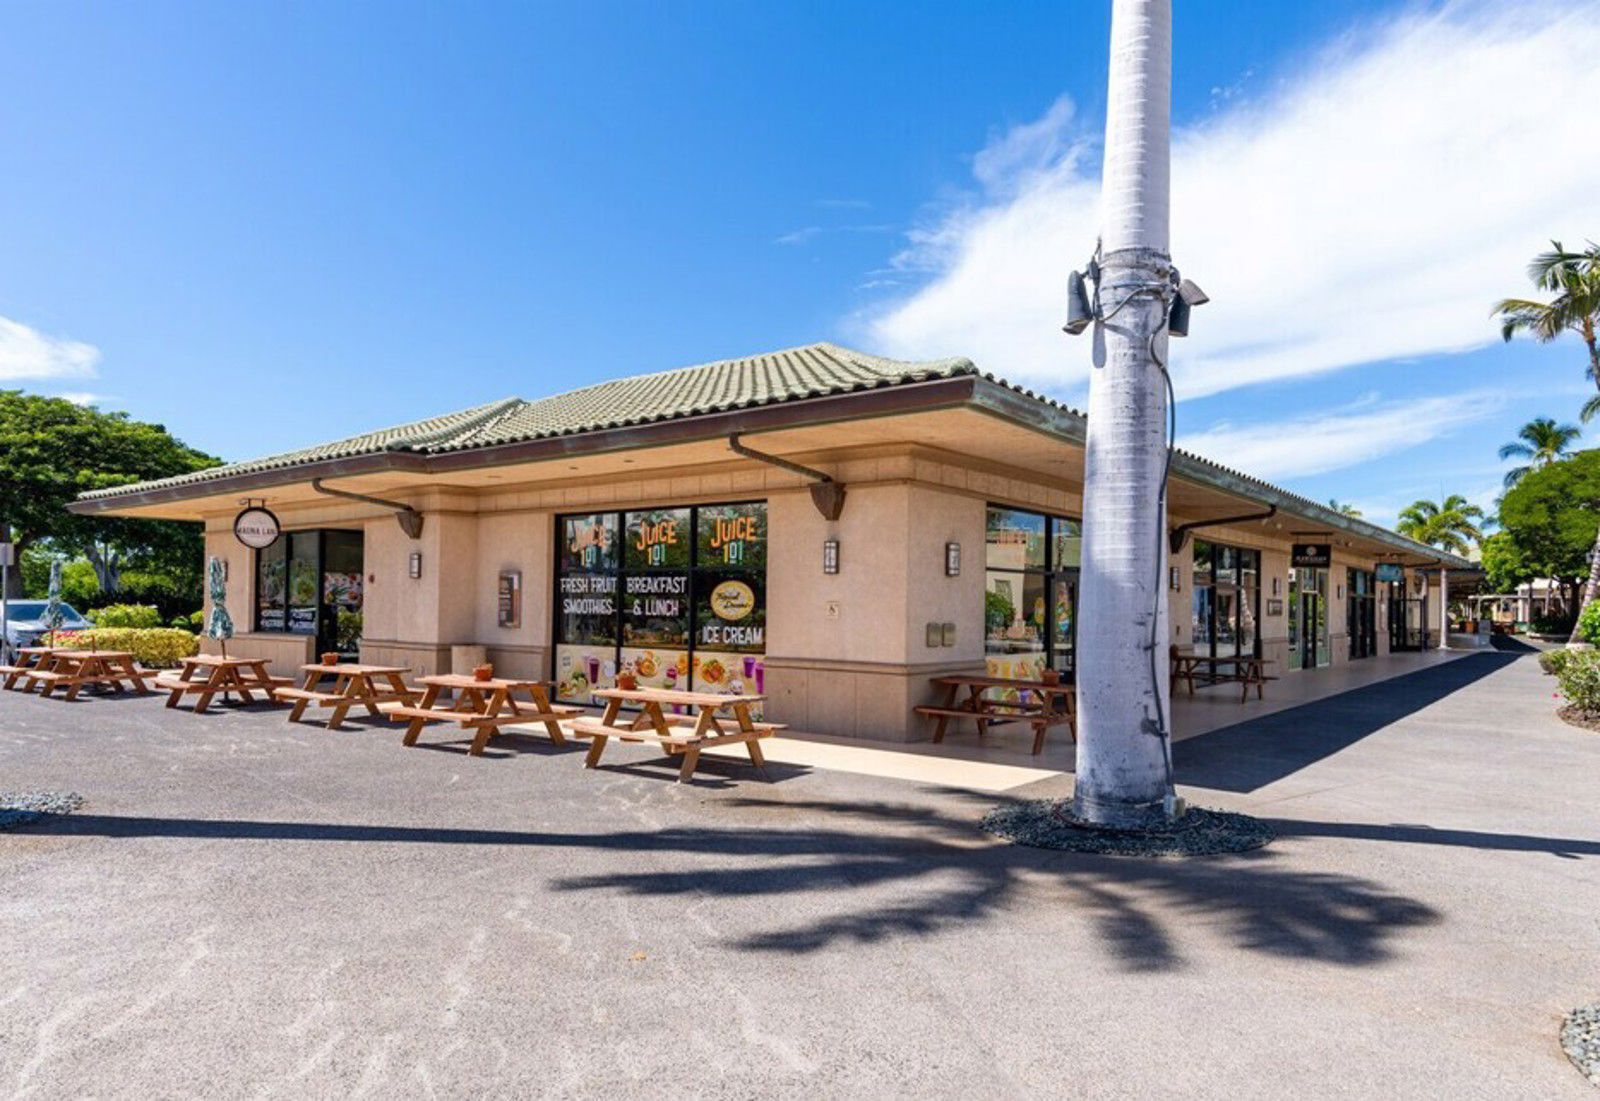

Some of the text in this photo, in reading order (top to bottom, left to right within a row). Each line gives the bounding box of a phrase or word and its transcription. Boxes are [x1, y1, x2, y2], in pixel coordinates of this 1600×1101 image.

[636, 520, 679, 550] JUICE
[711, 516, 756, 547] JUICE
[581, 547, 597, 567] 101
[647, 543, 666, 565] 101
[724, 542, 743, 564] 101
[560, 577, 618, 593] FRESH FRUIT
[626, 577, 687, 593] BREAKFAST
[563, 600, 613, 616] SMOOTHIES
[633, 600, 679, 616] & LUNCH
[702, 626, 763, 645] ICE CREAM
